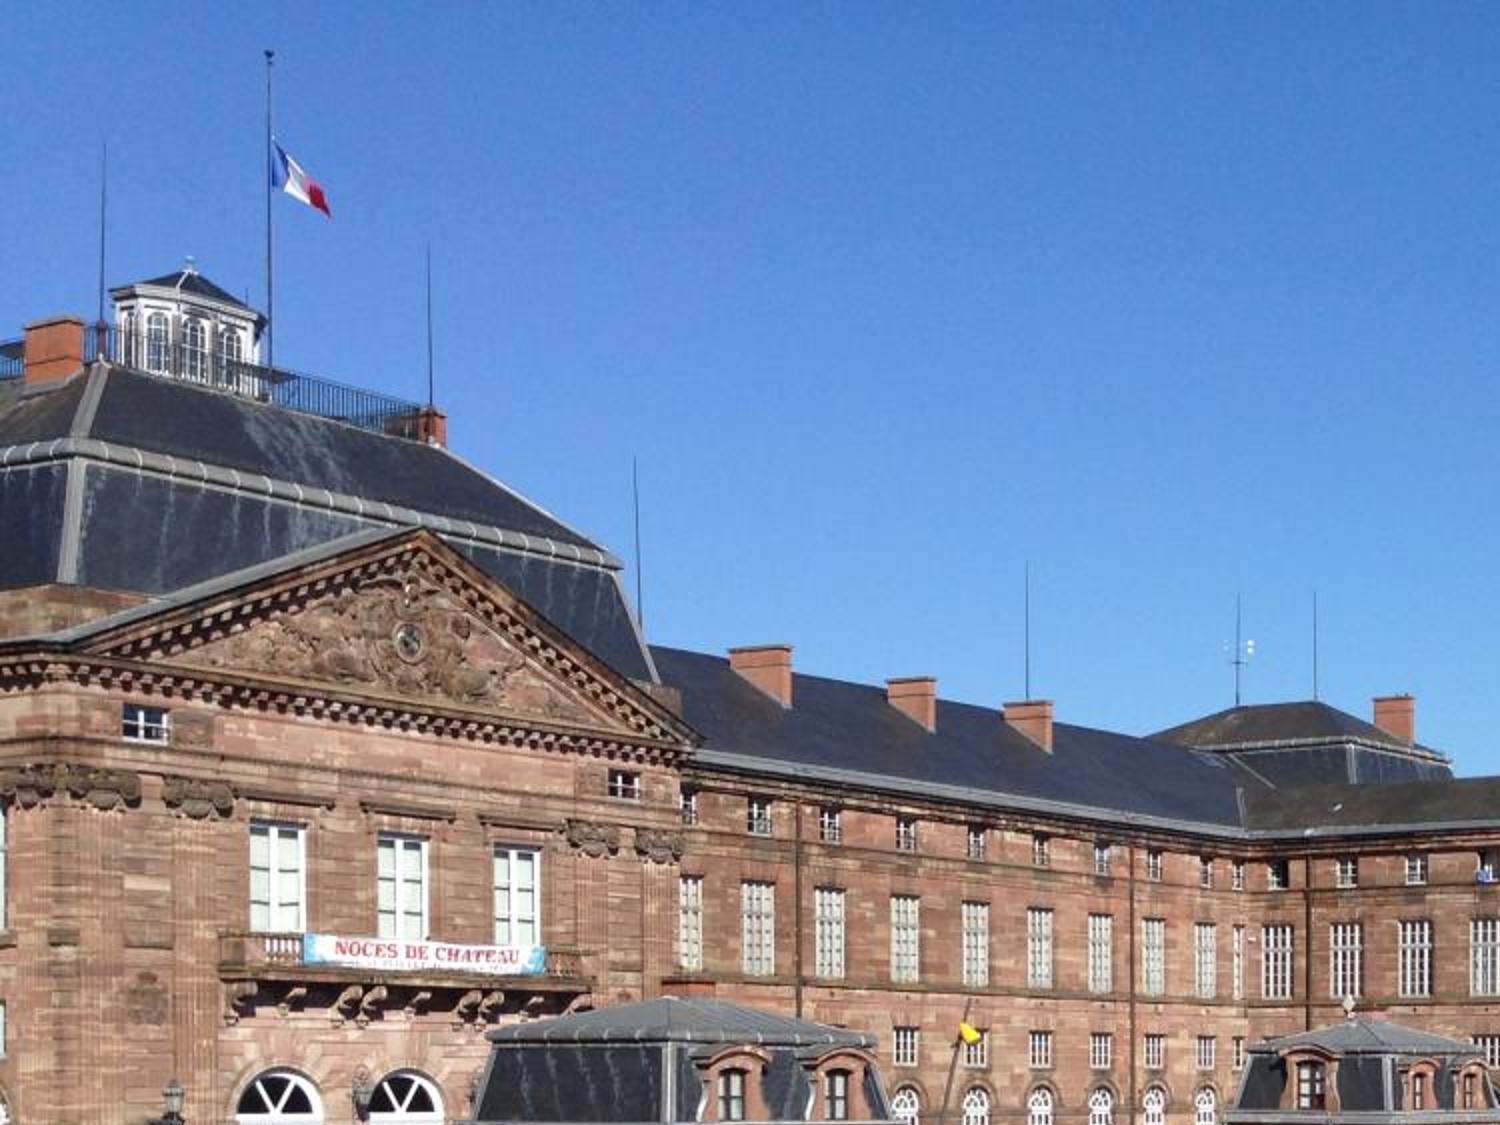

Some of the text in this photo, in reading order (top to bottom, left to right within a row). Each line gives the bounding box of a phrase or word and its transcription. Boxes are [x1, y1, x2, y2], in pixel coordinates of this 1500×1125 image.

[335, 940, 520, 964] NOCES DE CHATEAU
